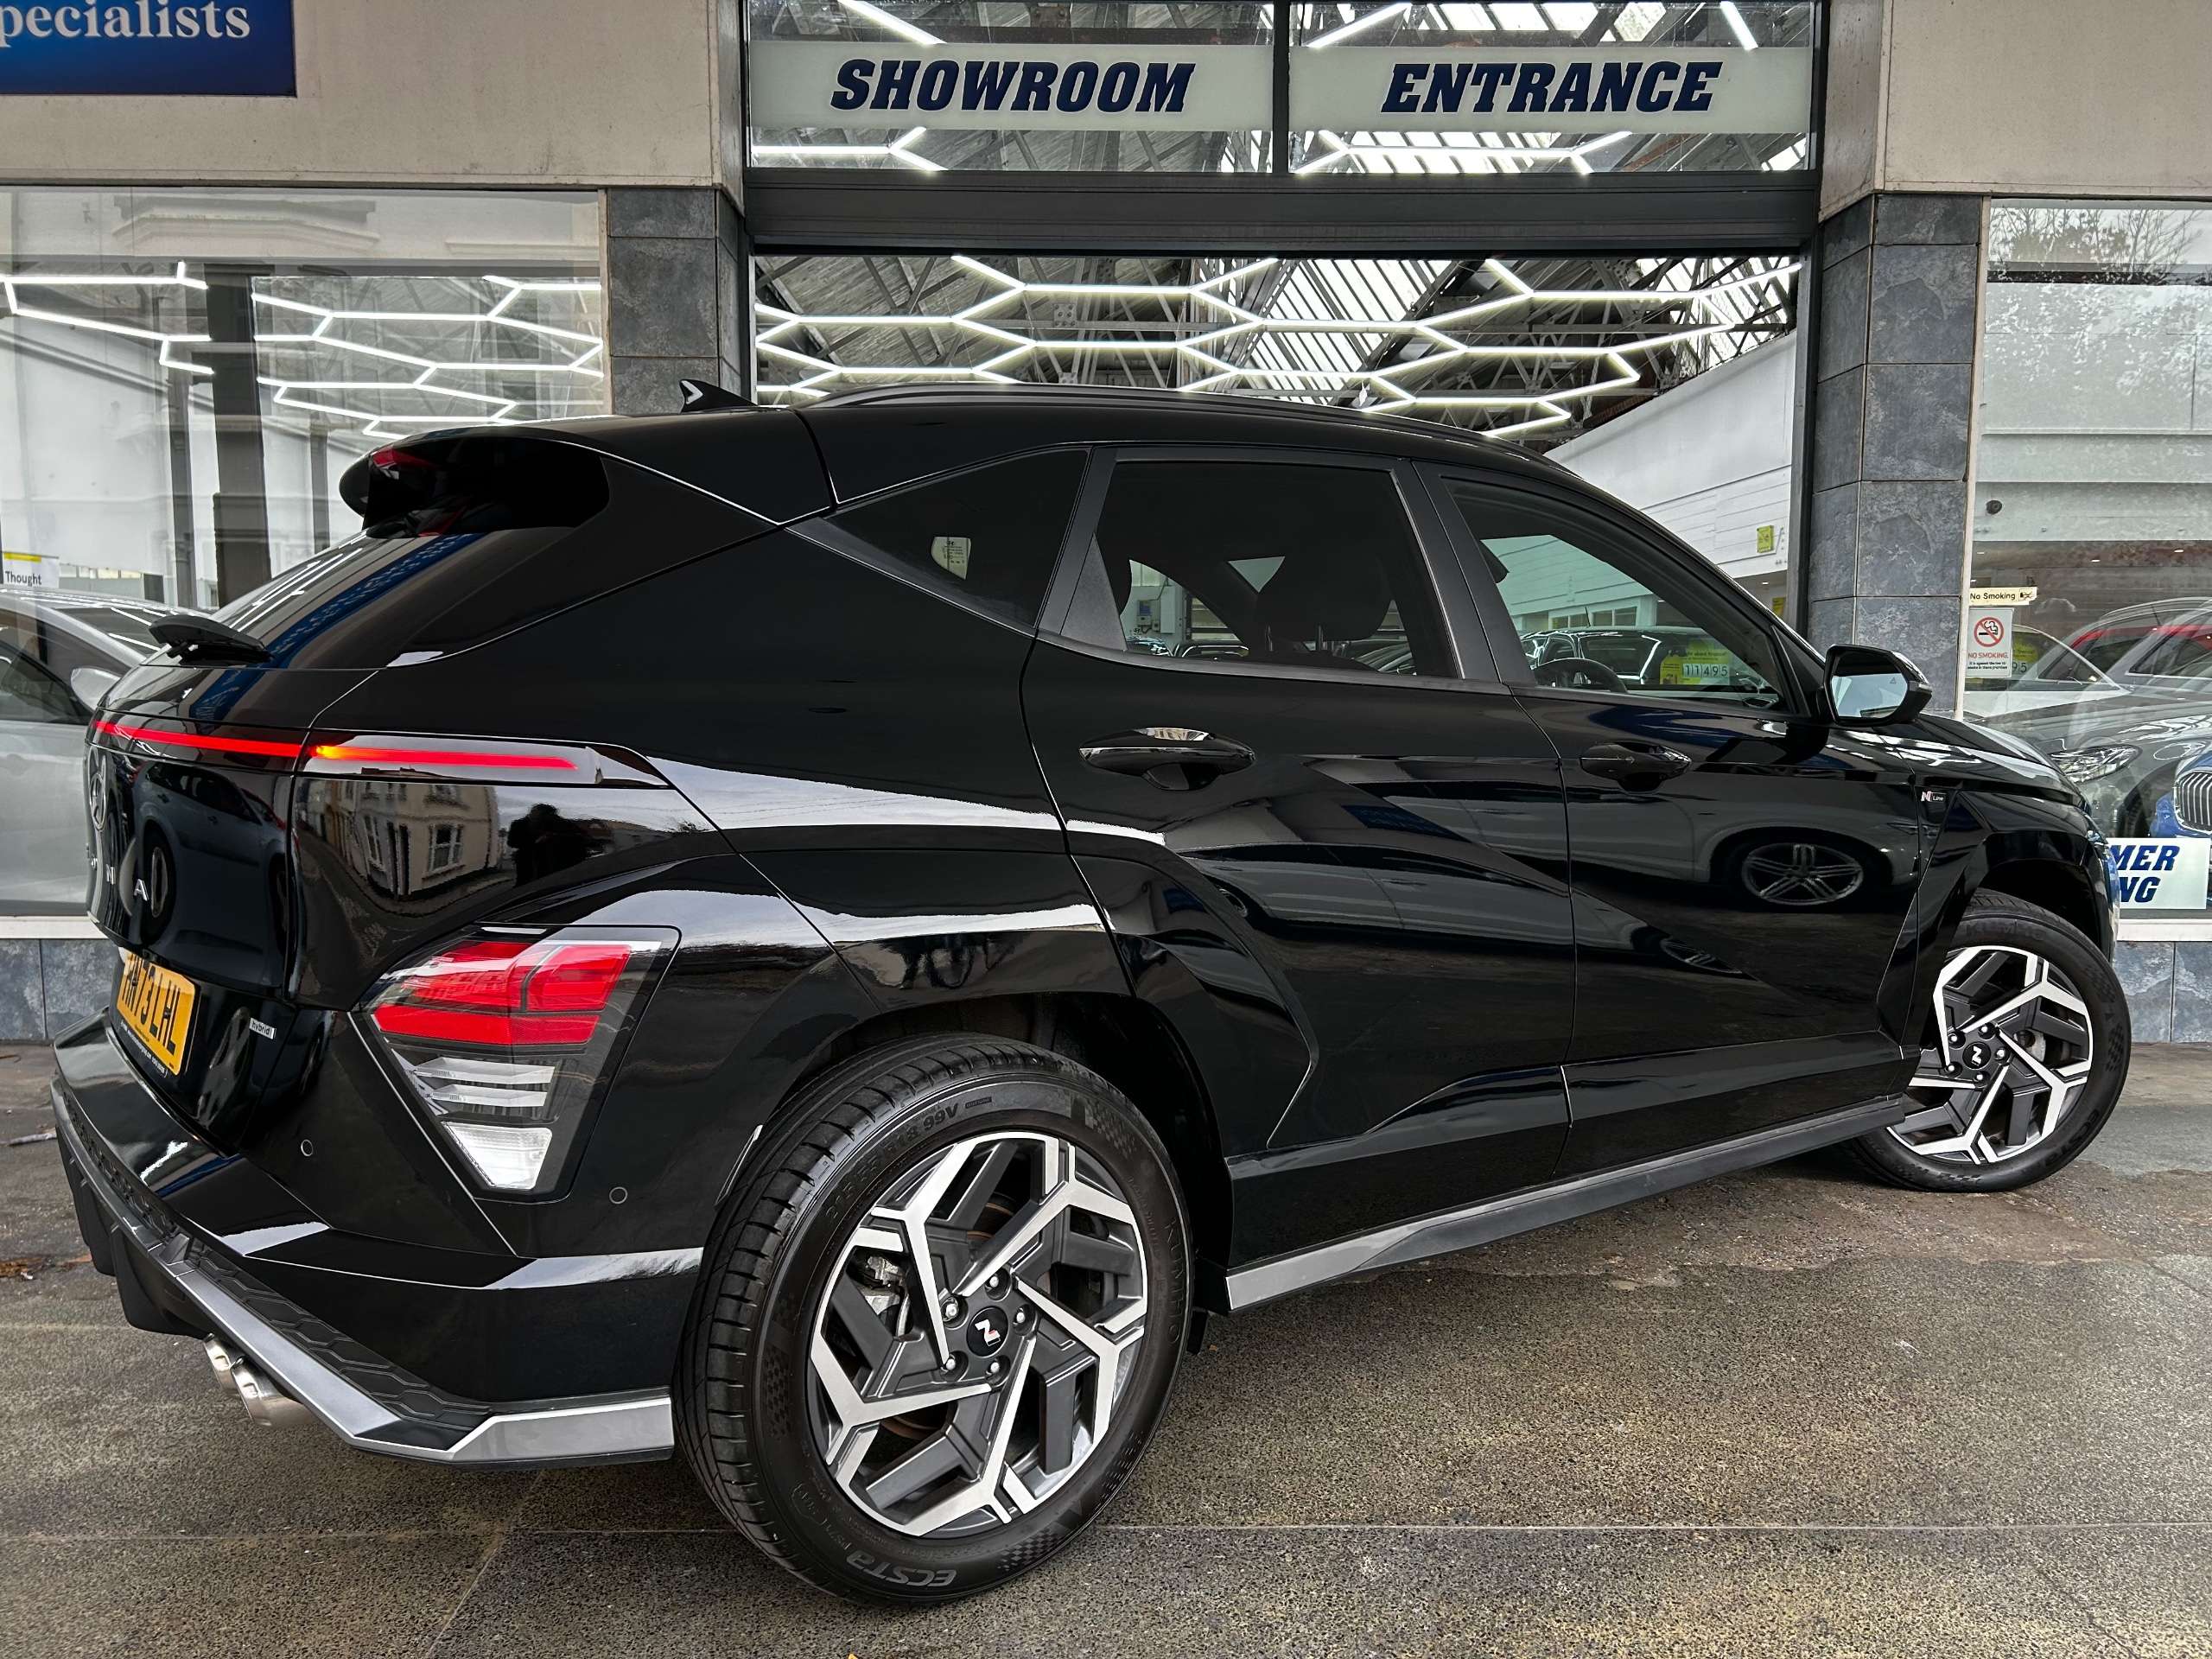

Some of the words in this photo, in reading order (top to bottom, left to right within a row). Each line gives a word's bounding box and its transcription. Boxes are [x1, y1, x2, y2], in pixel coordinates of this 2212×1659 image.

[830, 59, 1196, 113] SHOWROOM
[1381, 60, 1724, 113] ENTRANCE
[5, 570, 42, 587] Thought
[251, 1020, 270, 1035] hybrid
[924, 1103, 958, 1131] 99V
